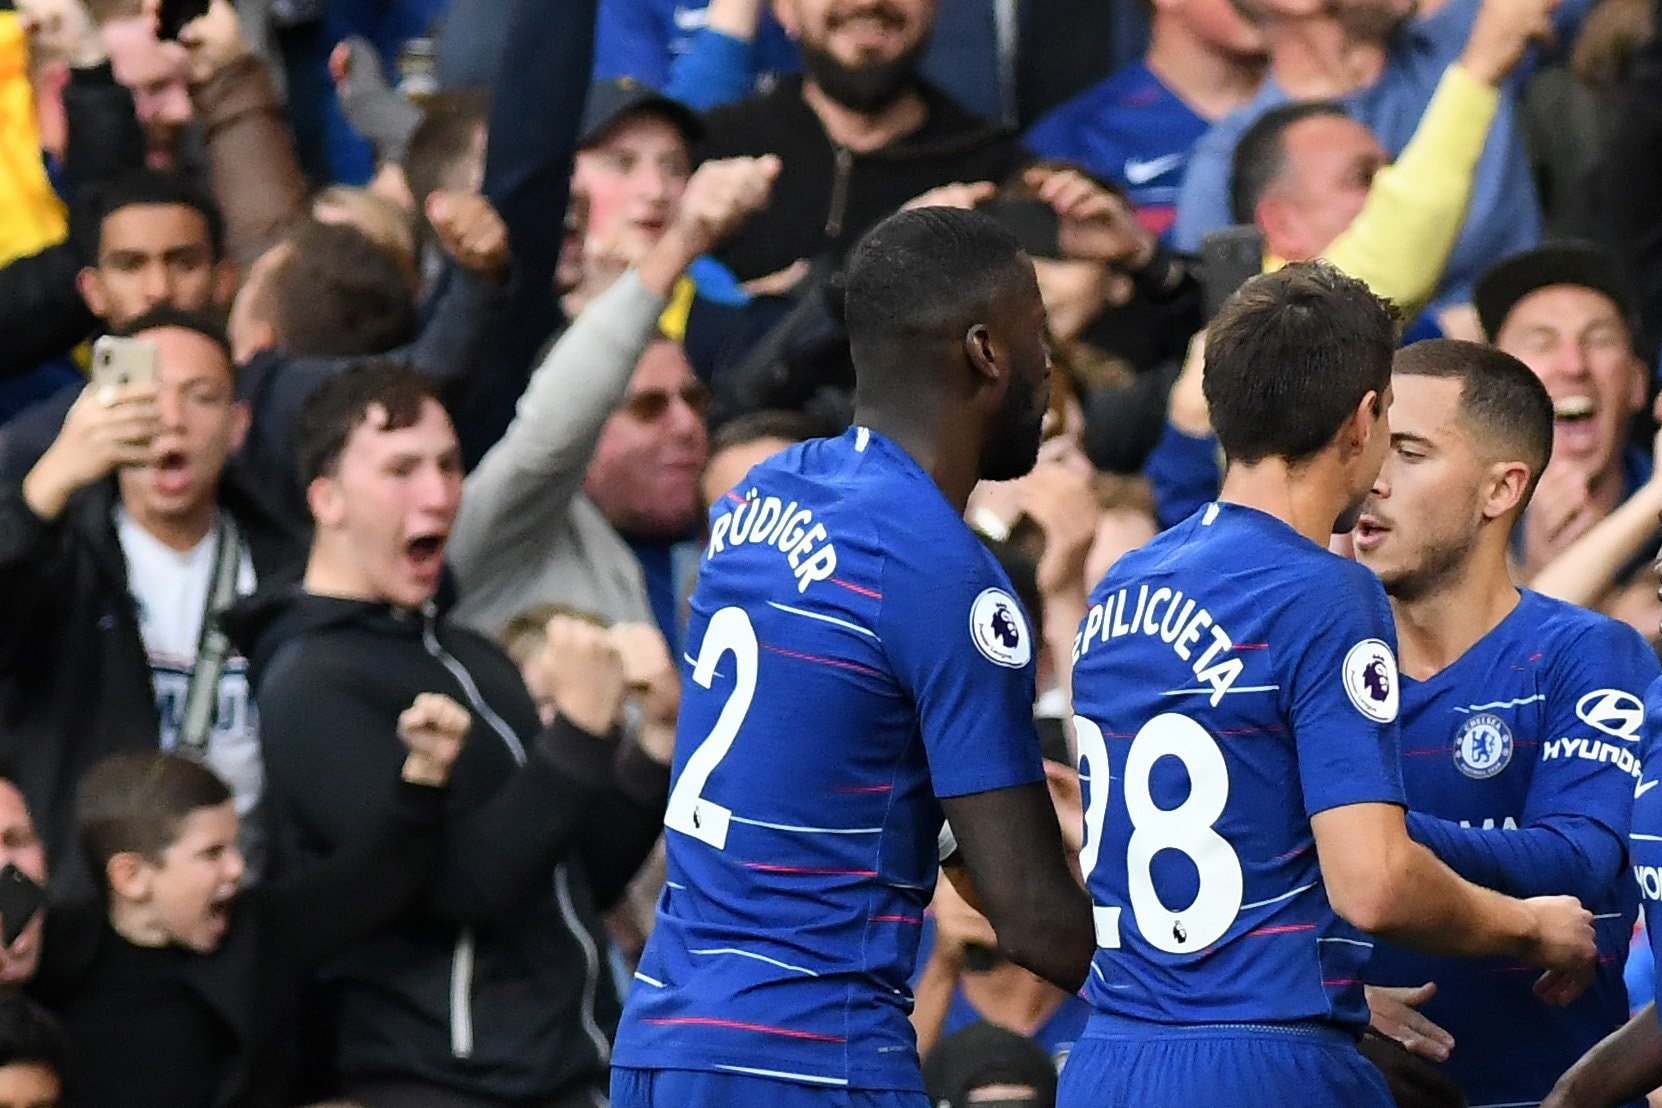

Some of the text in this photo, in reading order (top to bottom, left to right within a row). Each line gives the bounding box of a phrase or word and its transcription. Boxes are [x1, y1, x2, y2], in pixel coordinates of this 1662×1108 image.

[708, 487, 837, 593] RÜDIGER
[664, 606, 759, 850] 2
[1073, 712, 1243, 954] 28
